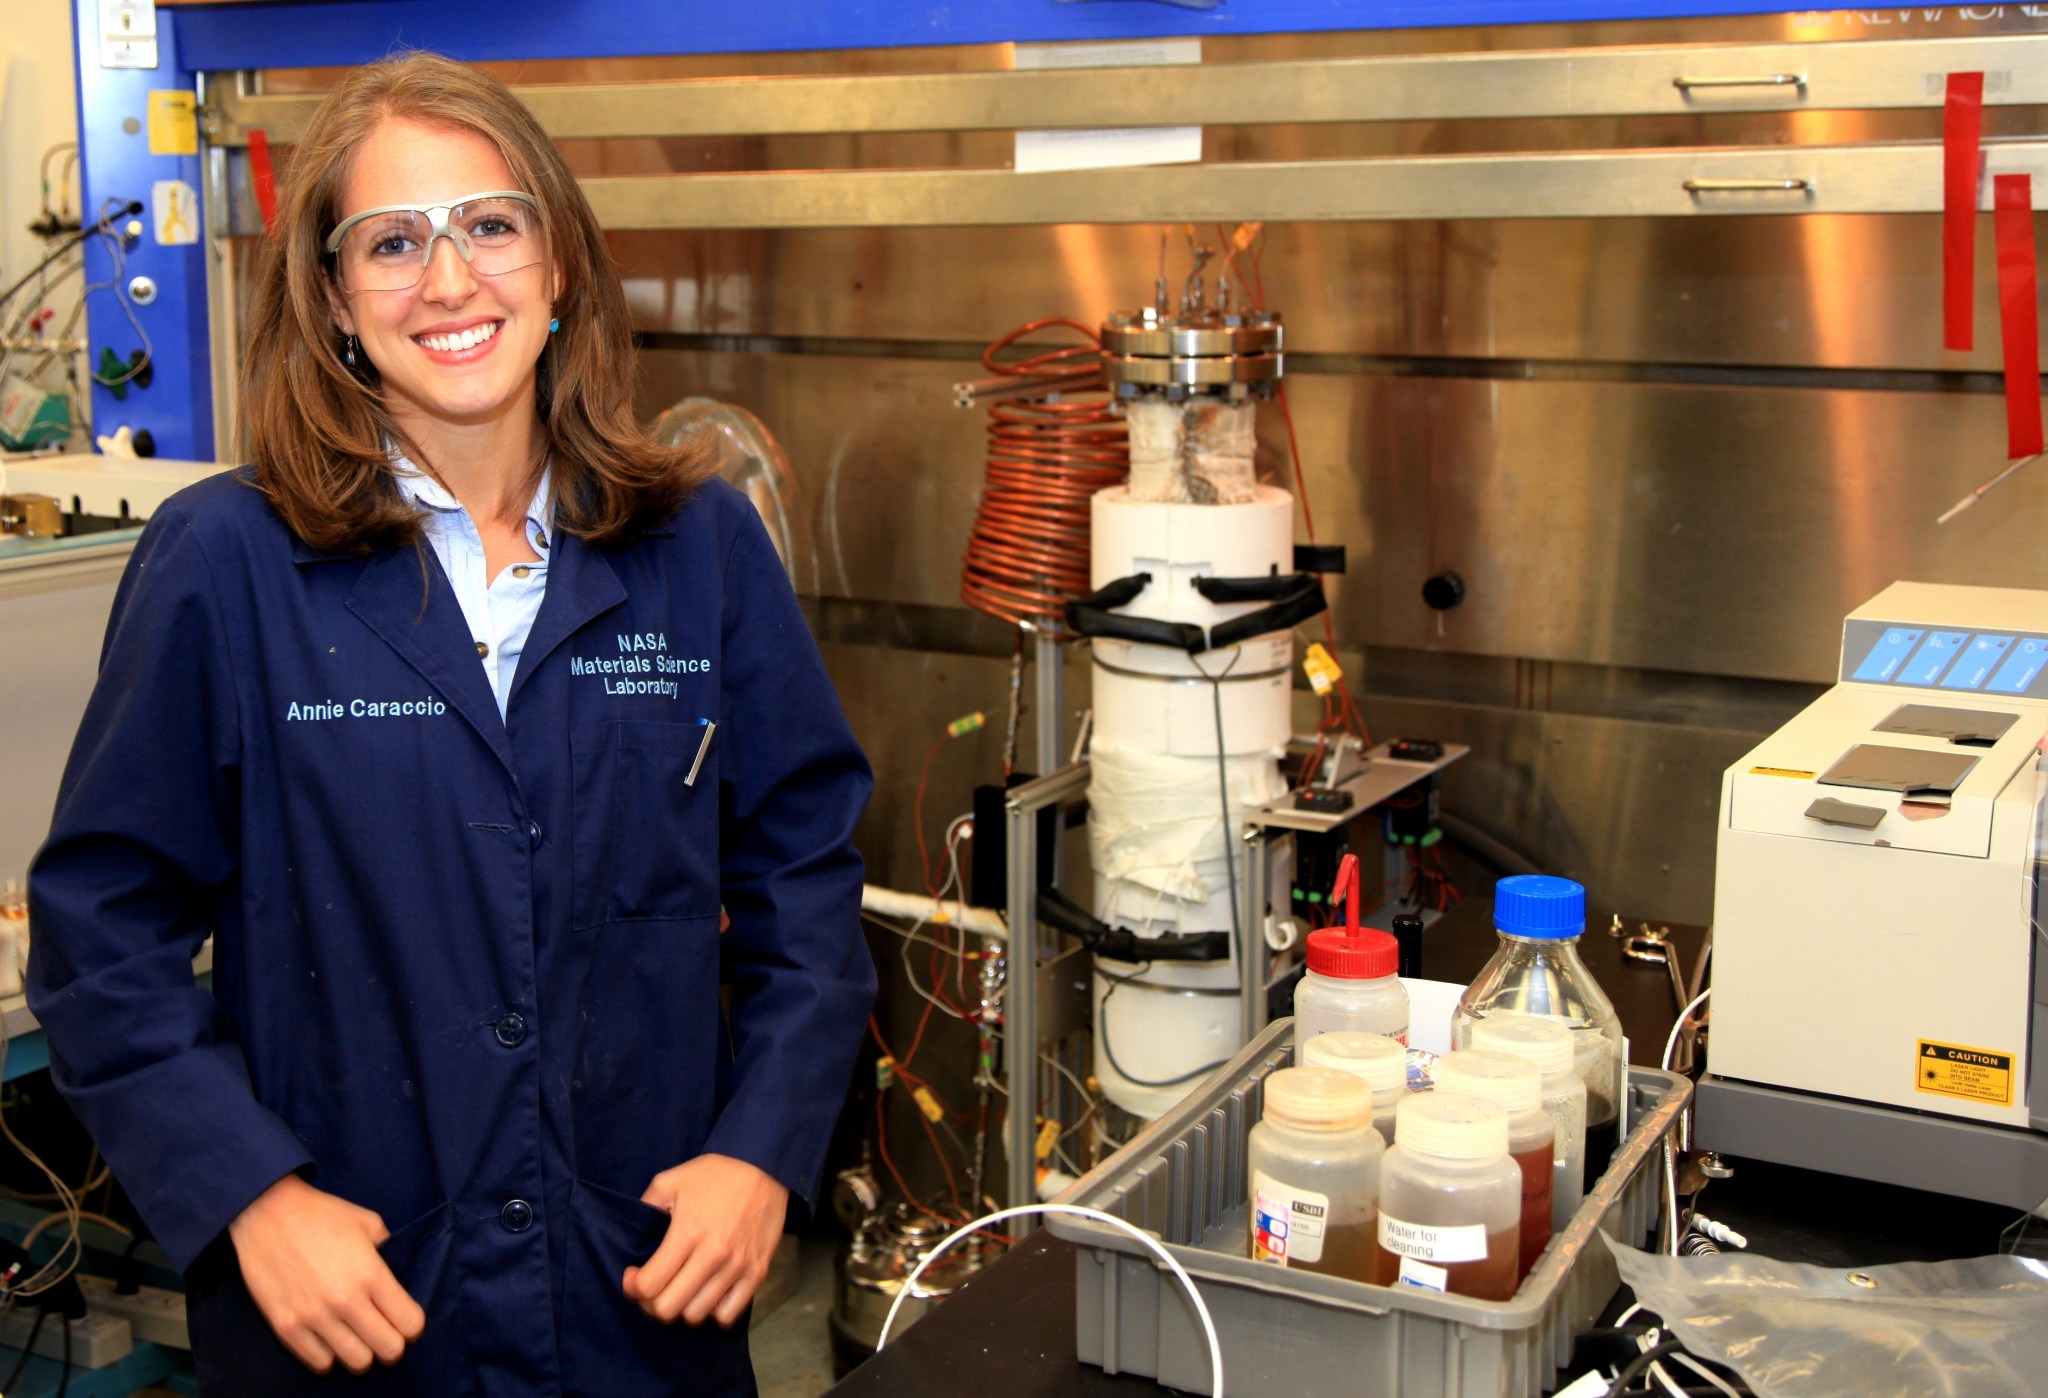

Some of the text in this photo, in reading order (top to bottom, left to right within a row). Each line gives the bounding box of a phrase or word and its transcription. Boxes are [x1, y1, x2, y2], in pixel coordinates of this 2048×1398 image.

[618, 633, 667, 652] NASA
[570, 655, 711, 676] Materials Science
[604, 677, 678, 700] Laboratory
[287, 696, 446, 721] Annie Caraccio
[1948, 1050, 1998, 1065] CAUTION
[1963, 1075, 1980, 1083] BEAM
[1972, 1071, 1989, 1079] STARE
[1961, 1086, 1978, 1094] LASER
[1293, 1201, 1321, 1216] USBI
[1387, 1220, 1439, 1243] Water for
[1387, 1236, 1434, 1259] cleaning
